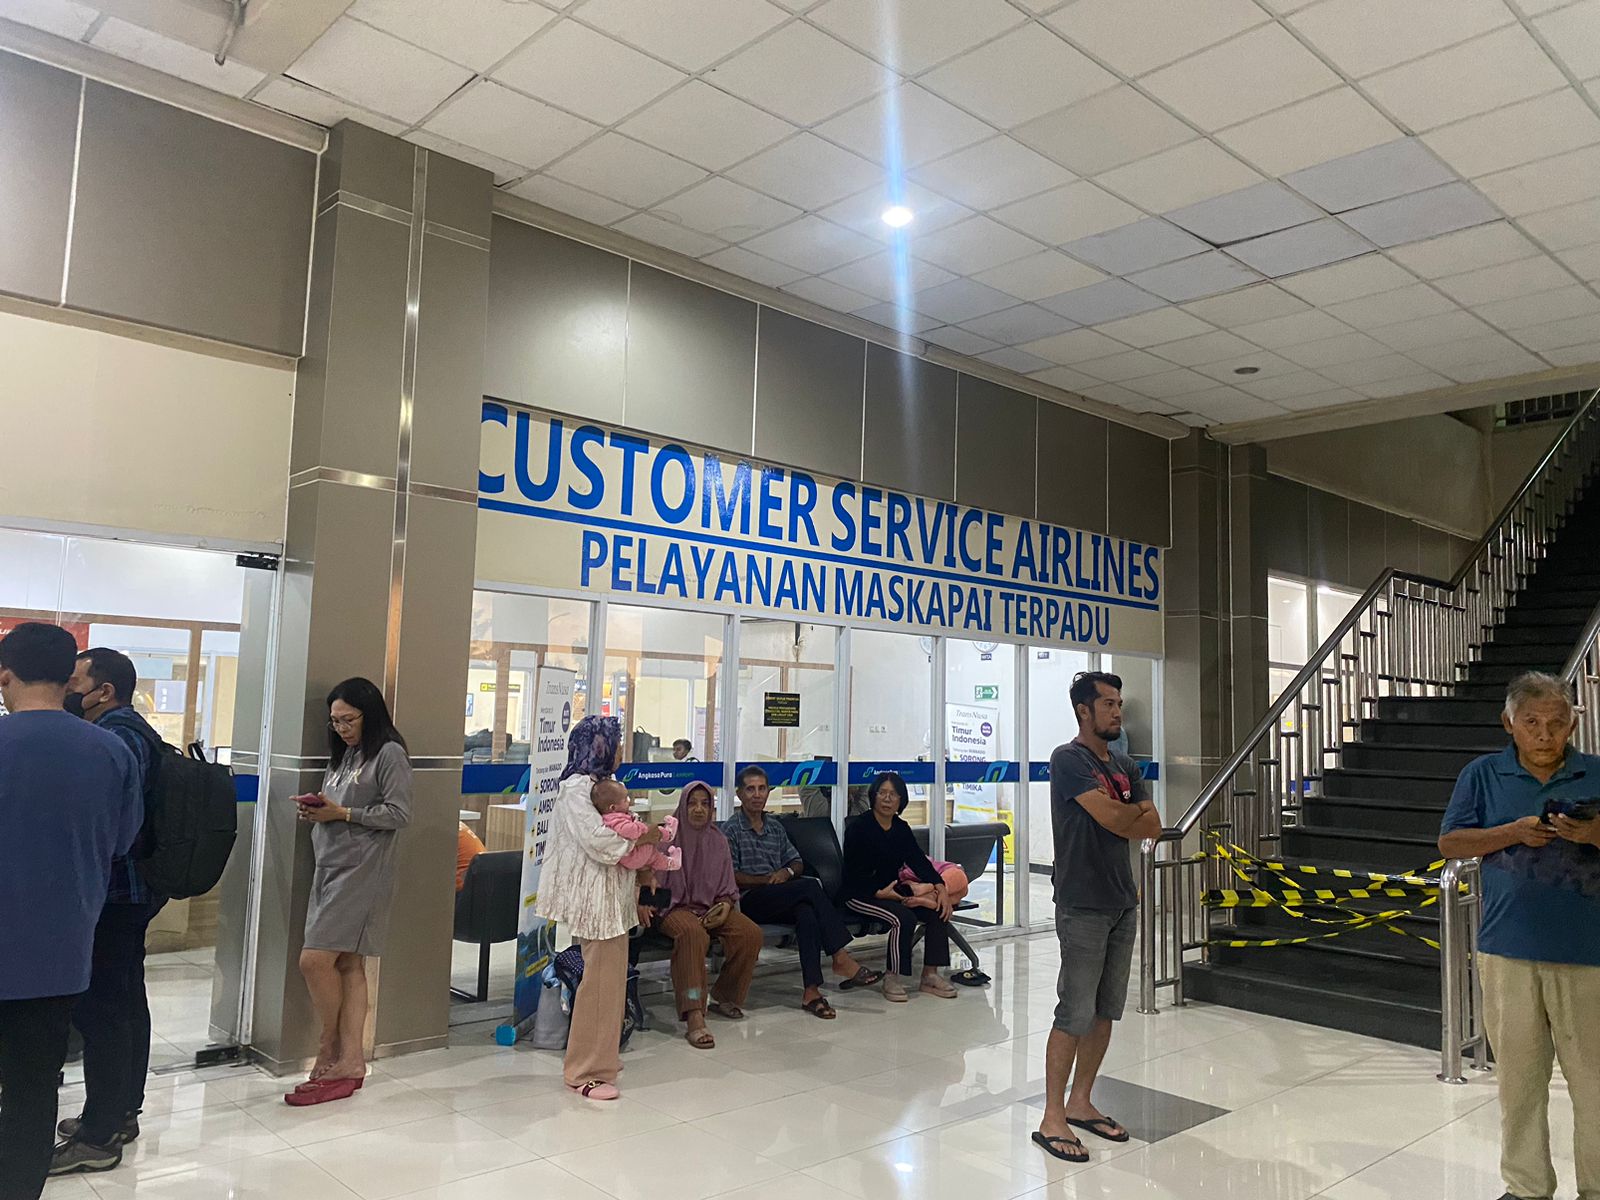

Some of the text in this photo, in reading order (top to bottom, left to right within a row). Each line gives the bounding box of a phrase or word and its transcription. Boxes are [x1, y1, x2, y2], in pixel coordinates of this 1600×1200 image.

[478, 402, 1159, 600] CUSTOMER SERVICE AIRLINES
[580, 530, 1110, 645] PELAYANAN MASKAPAI TERPADU
[539, 717, 556, 733] Timur
[952, 725, 973, 735] Timur
[538, 735, 565, 752] Indonesia
[952, 734, 986, 745] Indonesia
[540, 777, 560, 794] SORON
